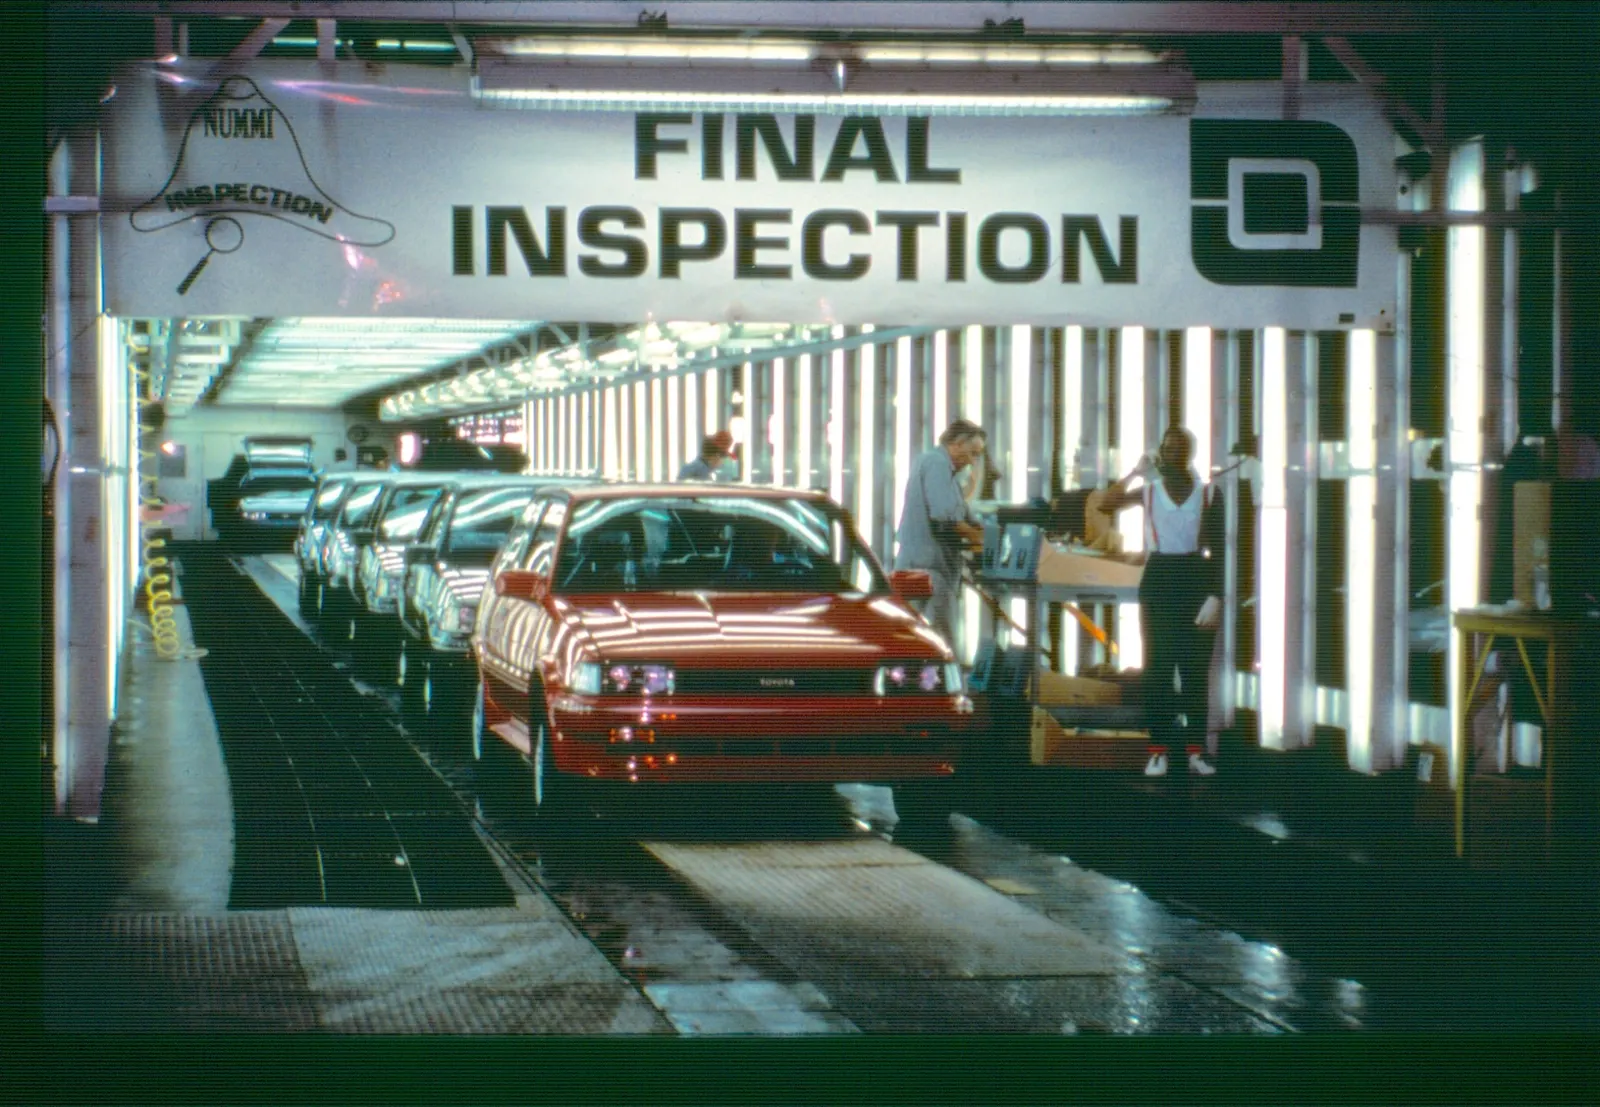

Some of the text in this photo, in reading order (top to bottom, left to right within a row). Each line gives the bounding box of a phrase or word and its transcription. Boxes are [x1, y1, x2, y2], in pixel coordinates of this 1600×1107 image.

[203, 107, 275, 139] NUMMI
[634, 112, 962, 184] FINAL
[165, 183, 334, 224] INSPECTION
[451, 204, 1139, 285] INSPECTION
